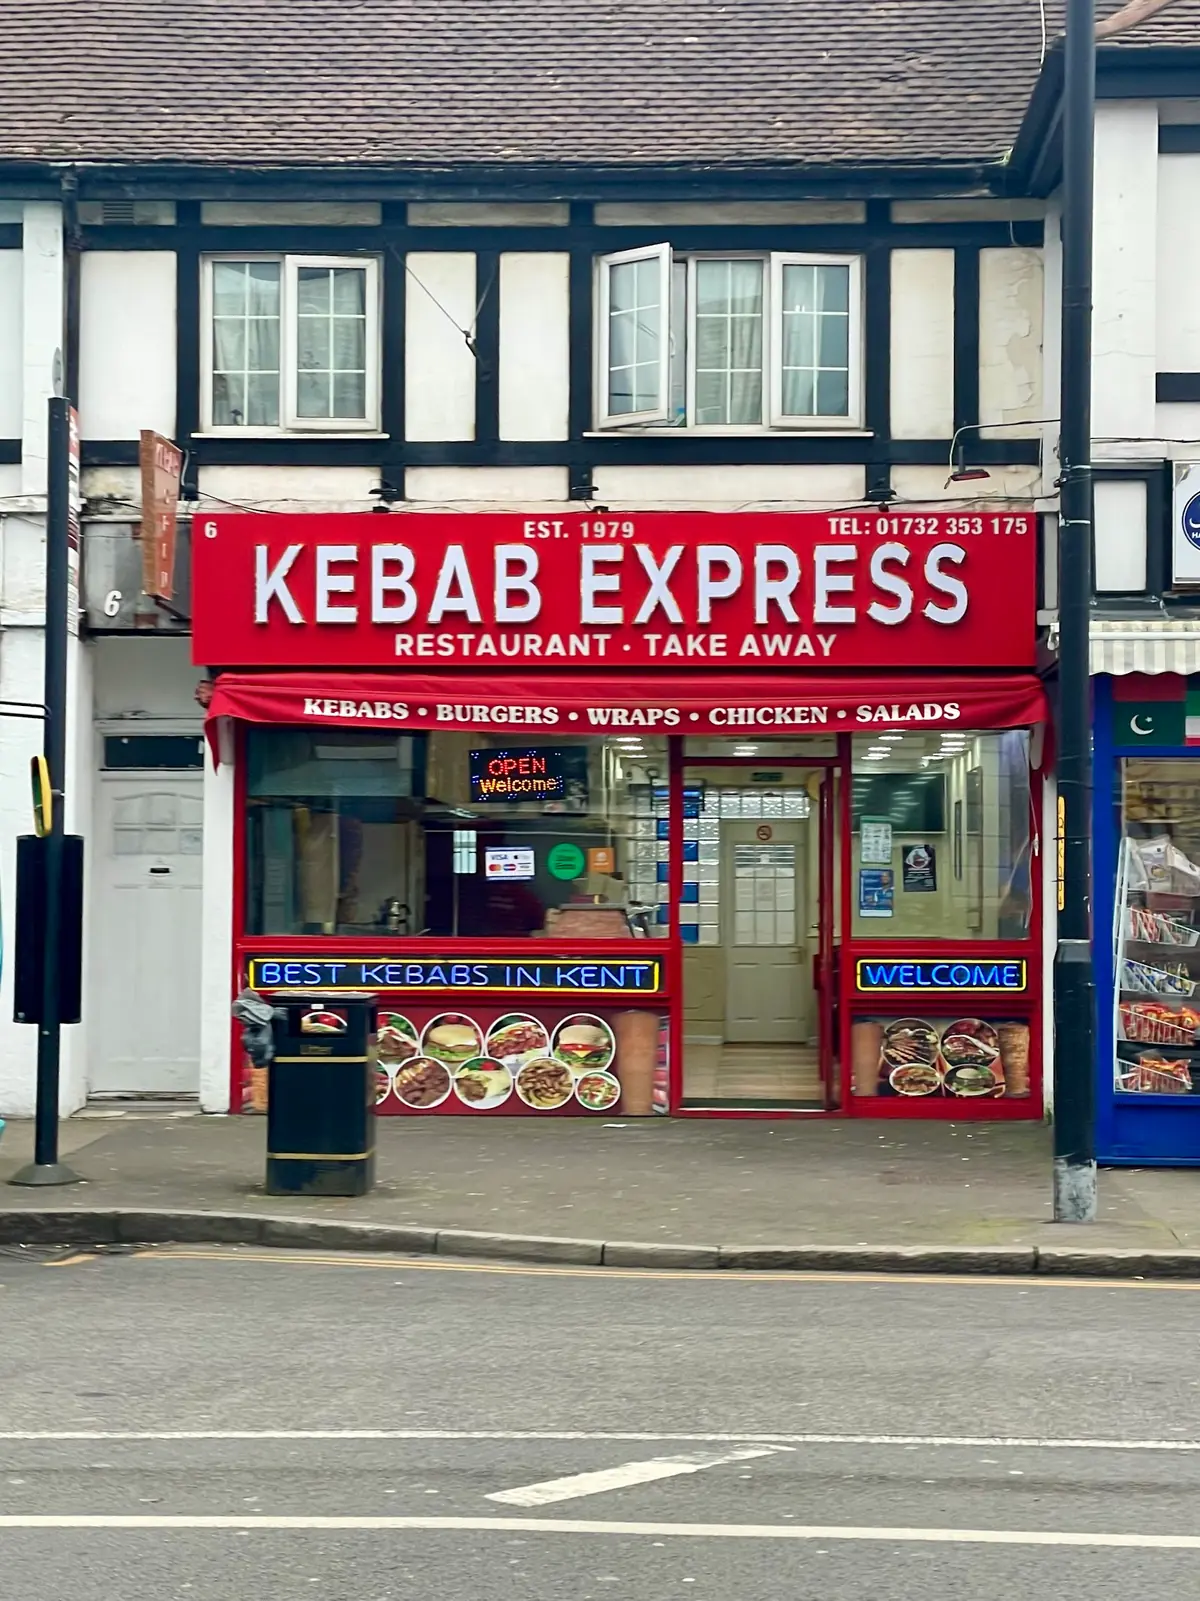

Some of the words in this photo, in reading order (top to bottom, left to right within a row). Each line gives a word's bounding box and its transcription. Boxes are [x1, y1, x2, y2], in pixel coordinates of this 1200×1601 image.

[204, 521, 218, 539] 6
[523, 521, 569, 539] EST.
[580, 521, 635, 539] 1979
[828, 517, 871, 535] TEL:
[876, 517, 939, 535] 01732
[945, 517, 983, 535] 353
[990, 517, 1028, 535] 175
[254, 543, 544, 625] KEBAB
[579, 541, 969, 626] EXPRESS
[104, 590, 122, 617] 6
[395, 633, 612, 657] RESTAURANT
[643, 633, 728, 657] TAKE
[739, 633, 837, 657] AWAY
[303, 698, 409, 720] KEBABS
[435, 704, 560, 725] BURGERS
[586, 707, 681, 726] WRAPS
[708, 706, 829, 726] CHICKEN
[855, 702, 961, 724] SALADS
[488, 757, 546, 776] OPEN
[261, 962, 347, 985] BEST
[360, 963, 490, 986] KEBABS
[505, 965, 541, 987] IN
[556, 966, 650, 988] KENT
[865, 964, 1019, 987] WELCOME
